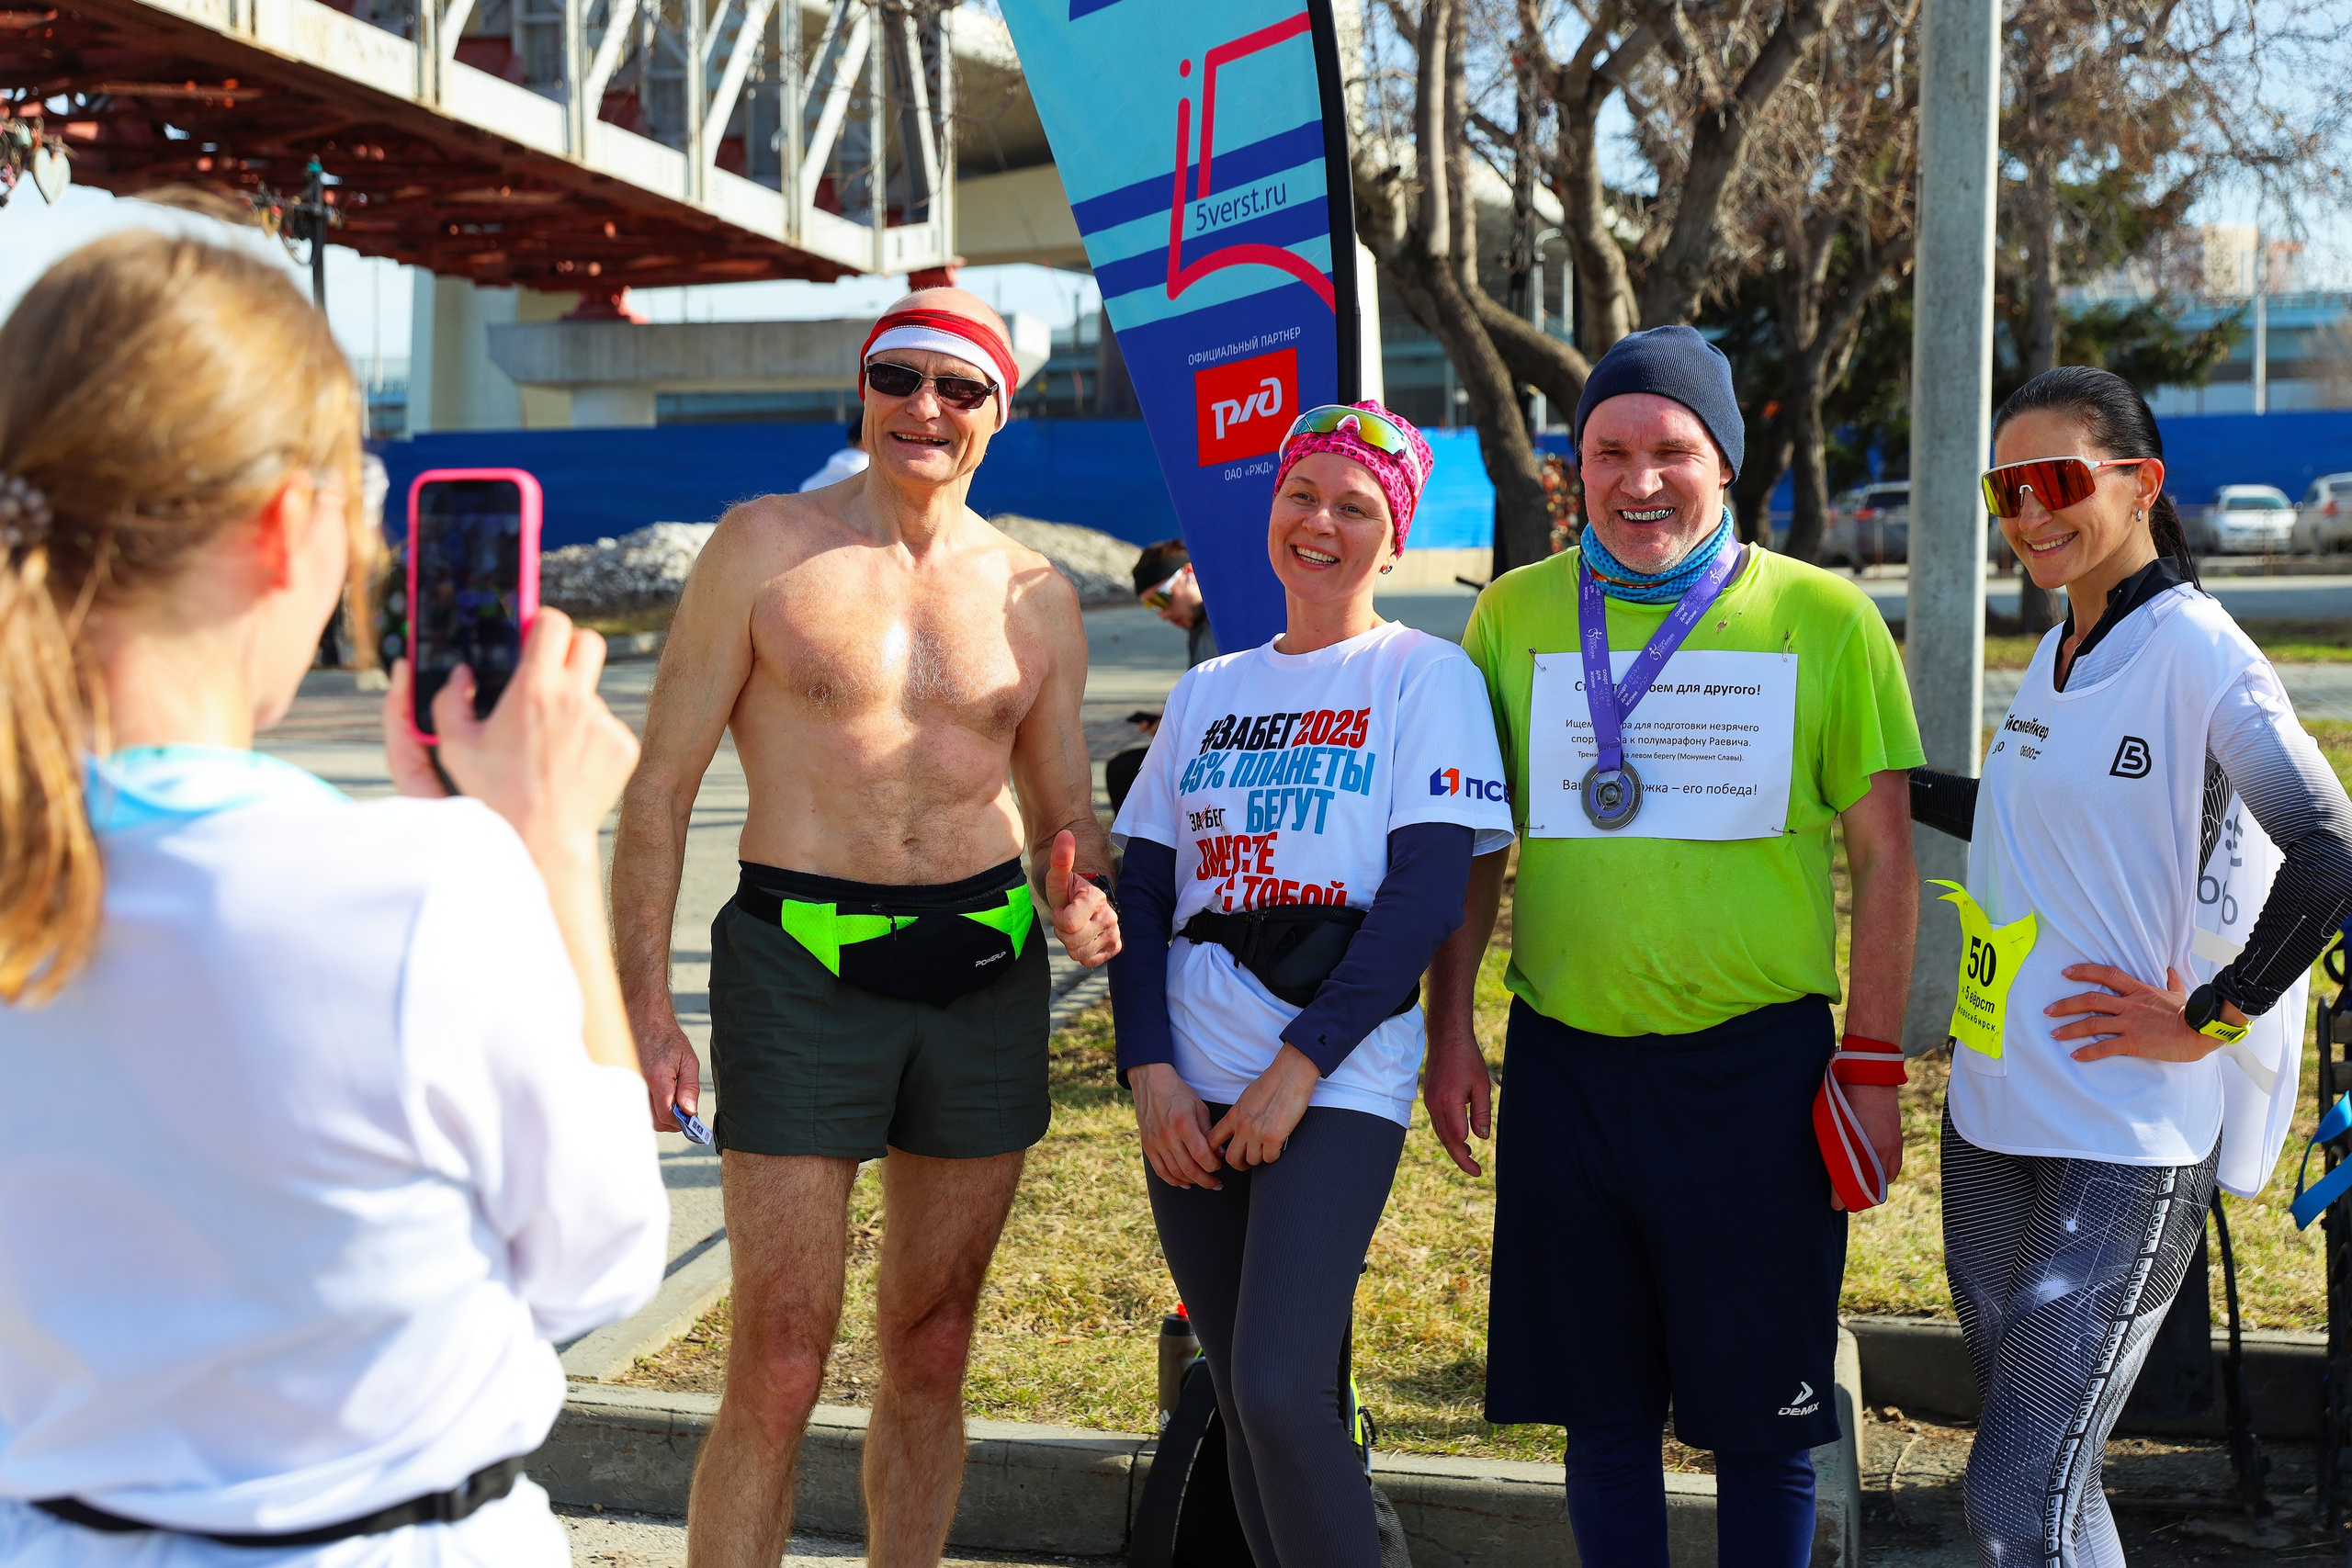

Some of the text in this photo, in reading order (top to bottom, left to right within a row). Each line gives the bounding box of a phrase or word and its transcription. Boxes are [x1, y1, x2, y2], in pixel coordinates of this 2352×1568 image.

[1196, 183, 1286, 231] 5verst.ru
[1188, 326, 1301, 366] ОФИЦИАЛЬНЫЙ ПАРТНЕР
[1225, 462, 1274, 481] ОАО «РЖД»
[1676, 683, 1701, 695] для
[1703, 684, 1761, 696] другого!
[1199, 706, 1371, 755] #ЗАБЕГ2025
[1566, 719, 1593, 733] Ищем
[1634, 722, 1651, 732] для
[1654, 722, 1707, 732] подготовки
[1710, 723, 1759, 733] незрячего
[2004, 714, 2049, 742] йсмейкер
[1638, 736, 1706, 747] полумарафону
[1709, 737, 1751, 747] Раевича.
[1654, 752, 1677, 761] берегу
[1678, 752, 1715, 761] (Монумент
[1717, 753, 1744, 762] Славы).
[1179, 747, 1376, 796] 45% ПЛАНЕТЫ
[1682, 784, 1702, 795] его
[1706, 783, 1758, 797] победа!
[1246, 787, 1336, 834] БЕГУТ
[1967, 935, 1996, 987] 50
[1965, 986, 1971, 999] 5
[1970, 991, 1995, 1013] вёрст
[1778, 1402, 1819, 1416] DEMIX
